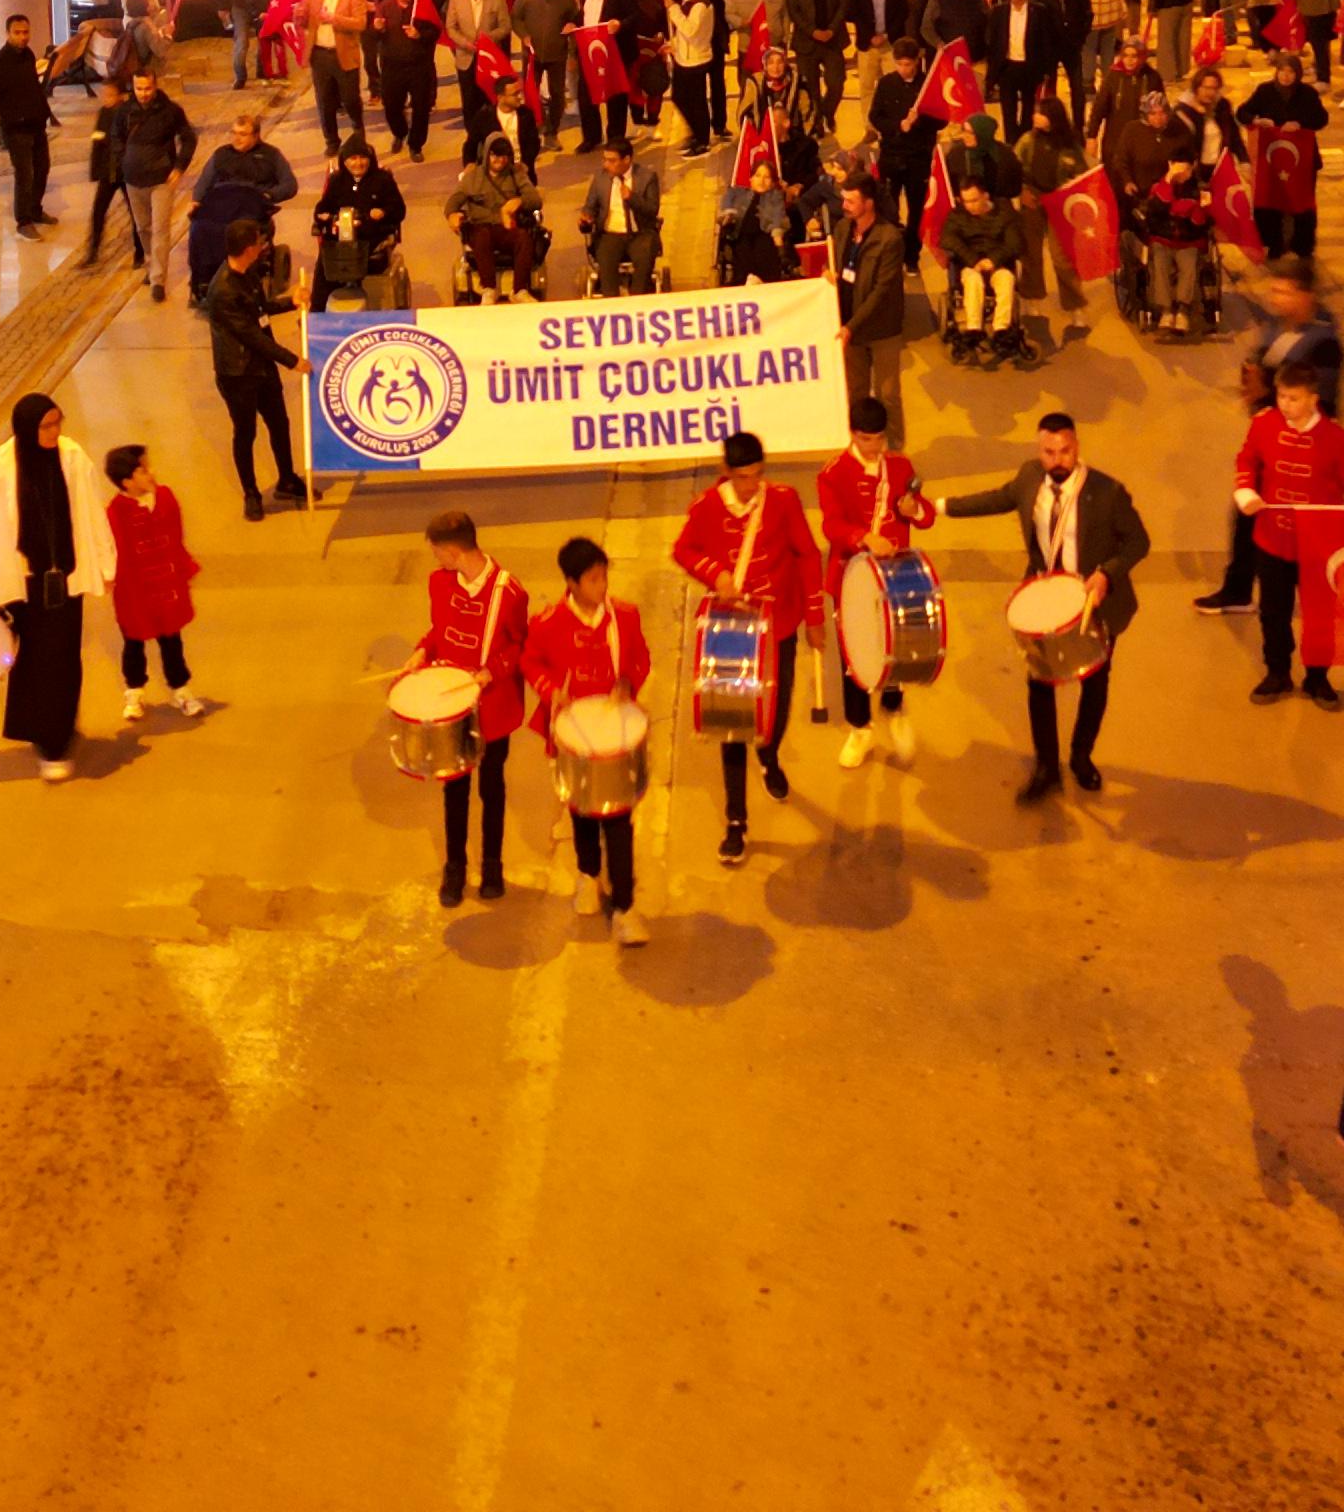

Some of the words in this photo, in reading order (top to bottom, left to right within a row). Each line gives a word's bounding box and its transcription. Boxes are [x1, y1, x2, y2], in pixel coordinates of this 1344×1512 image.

[487, 357, 584, 404] ÜMİT
[598, 344, 819, 404] ÇOCUKLARI
[413, 430, 440, 451] 2002
[572, 396, 742, 451] DERNEĞİ
